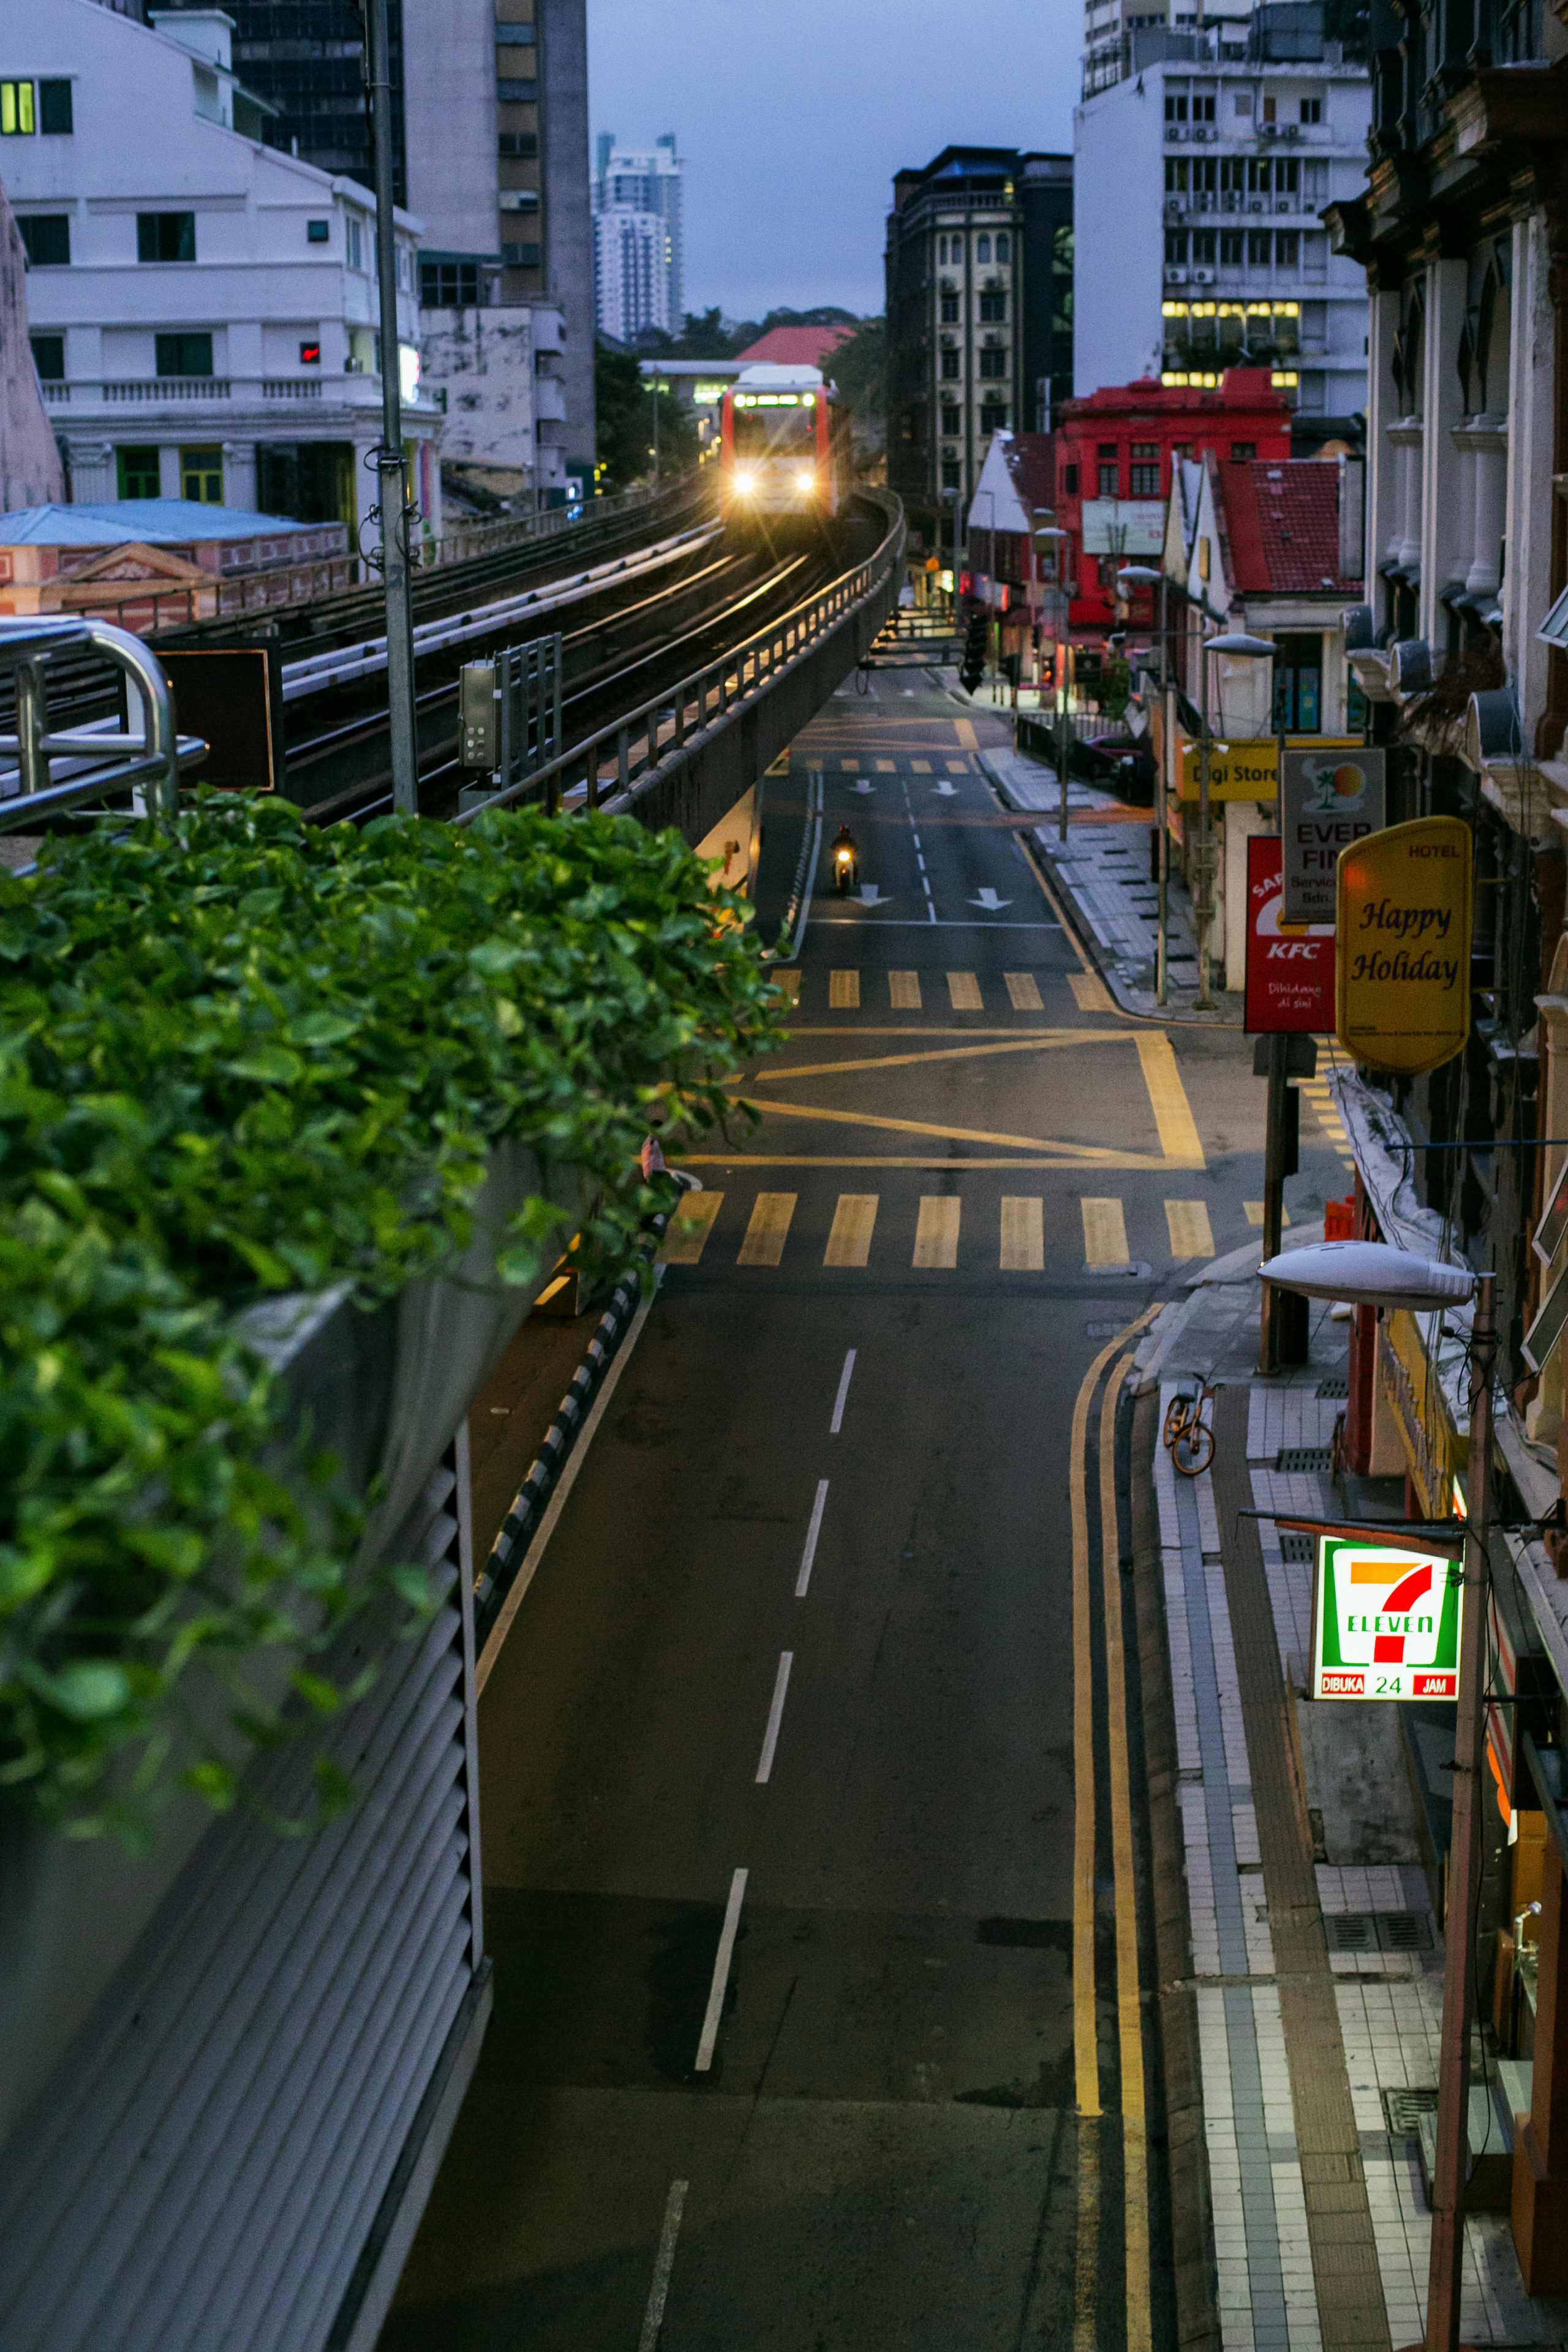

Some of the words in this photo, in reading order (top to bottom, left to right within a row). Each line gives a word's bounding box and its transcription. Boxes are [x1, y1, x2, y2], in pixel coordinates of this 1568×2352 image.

[1409, 845, 1460, 858] HOTEL
[1359, 898, 1452, 940] Happy
[1266, 942, 1321, 959] KFC
[1351, 950, 1459, 990] Holiday
[1268, 982, 1322, 998] Dihidang
[1277, 998, 1290, 1008] di
[1294, 998, 1311, 1009] sini
[1322, 1676, 1364, 1692] DIBUKA
[1376, 1677, 1402, 1694] 24
[1422, 1678, 1446, 1694] JAM
